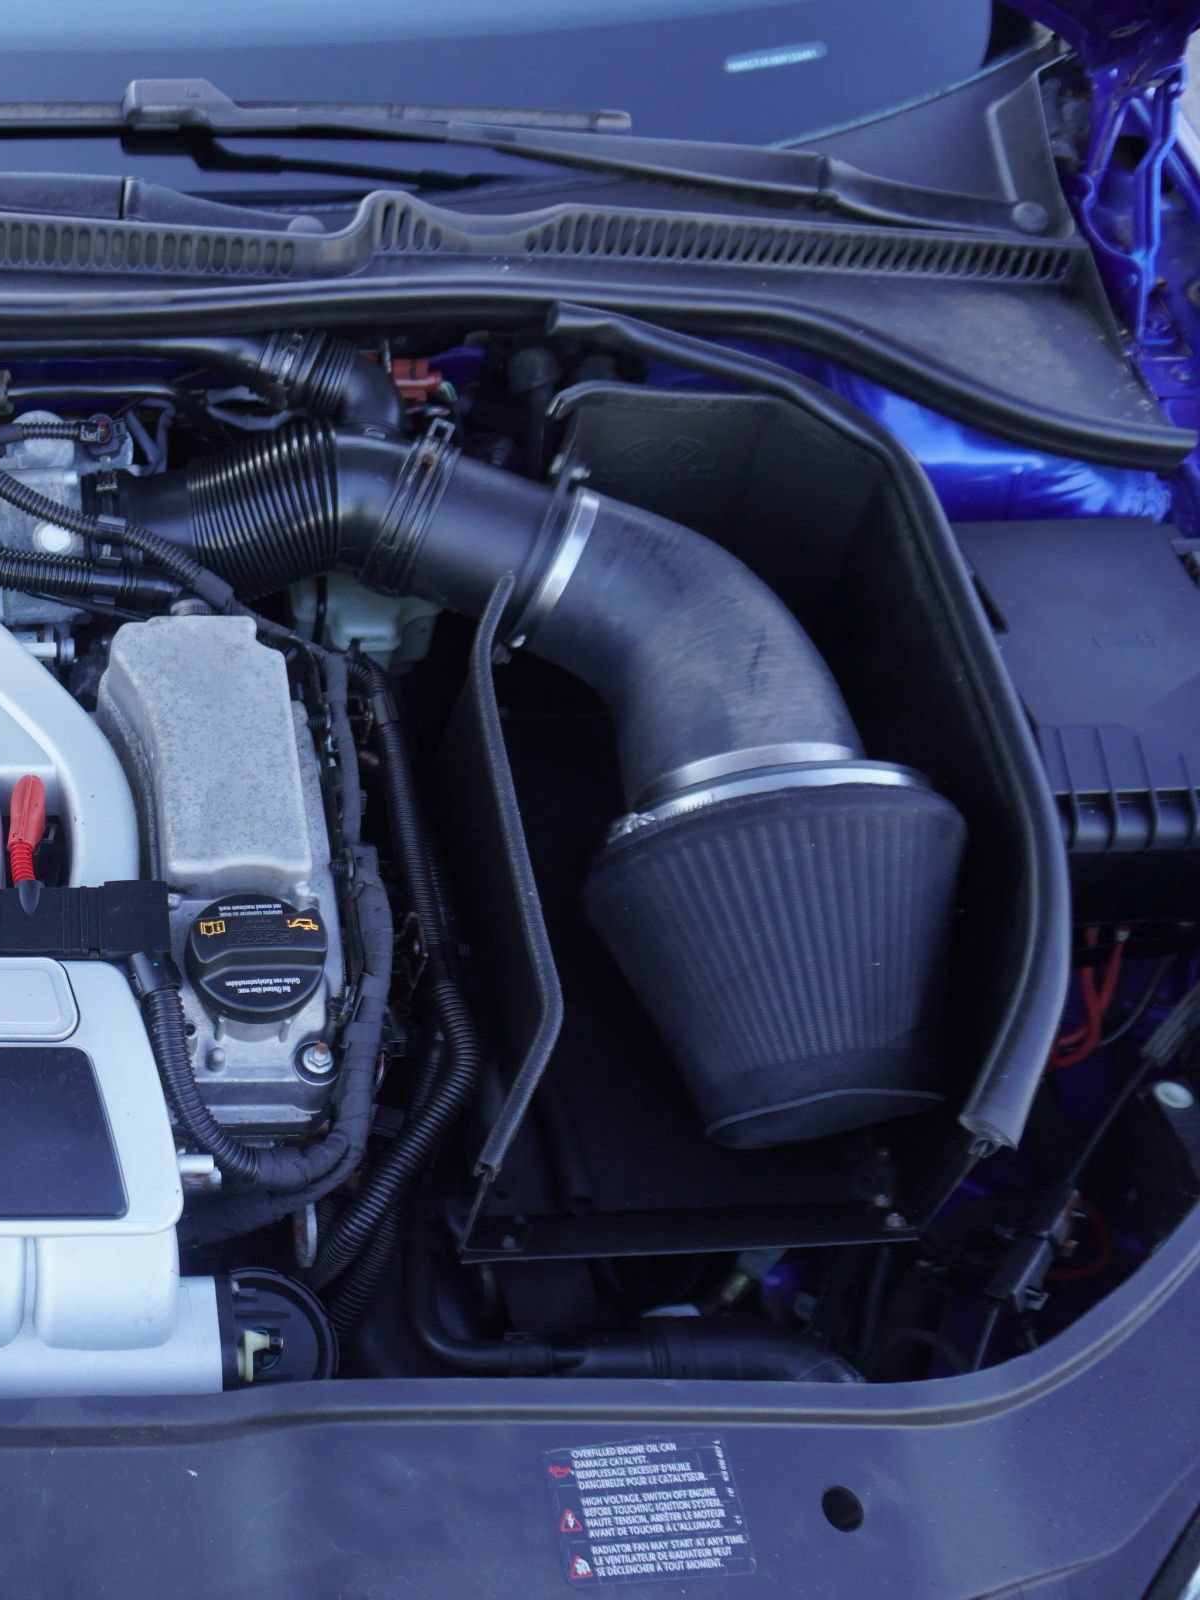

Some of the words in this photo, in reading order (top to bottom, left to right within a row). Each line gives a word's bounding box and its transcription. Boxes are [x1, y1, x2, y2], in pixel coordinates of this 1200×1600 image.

[571, 1447, 616, 1459] OVERFILLED
[617, 1444, 645, 1454] ENGINE
[646, 1443, 659, 1453] OIL
[660, 1442, 677, 1452] CAN
[574, 1458, 609, 1469] DAMAGE
[609, 1455, 649, 1467] CATALYST.
[575, 1468, 627, 1480] REMPLISSAGE
[628, 1464, 660, 1475] EXCESSIF
[661, 1462, 692, 1473] D'HUILE
[578, 1479, 626, 1490] DANGEREUX
[626, 1476, 648, 1486] POUR
[649, 1475, 657, 1485] LE
[658, 1472, 708, 1484] CATALYSEUR.
[581, 1496, 603, 1507] HIGH
[641, 1491, 672, 1502] SWITCH
[673, 1489, 687, 1499] OFF
[688, 1487, 717, 1498] ENGINE
[584, 1507, 613, 1518] BEFORE
[613, 1503, 654, 1515] TOUCHING
[656, 1500, 691, 1511] IGNITION
[691, 1497, 724, 1509] SYSTEM.
[586, 1517, 613, 1528] HAUTE
[684, 1510, 692, 1520] LE
[693, 1508, 726, 1519] MOTEUR
[589, 1528, 616, 1539] AVANT
[617, 1527, 628, 1536] DE
[629, 1524, 665, 1535] TOUCHER
[673, 1519, 724, 1531] L'ALLUMAGE.
[592, 1543, 632, 1555] RADIATOR
[633, 1541, 650, 1552] FAN
[651, 1540, 669, 1550] MAY
[671, 1538, 694, 1549] START
[696, 1537, 706, 1547] AT
[706, 1536, 724, 1546] ANY
[724, 1534, 747, 1545] TIME.
[594, 1556, 604, 1566] LE
[605, 1552, 656, 1564] VENTILATEUR
[657, 1551, 668, 1560] DE
[668, 1547, 712, 1560] RADIATEUR
[712, 1546, 732, 1557] PEUT
[596, 1566, 606, 1576] SE
[663, 1560, 685, 1571] TOUT
[686, 1557, 725, 1570] MOMENT.
